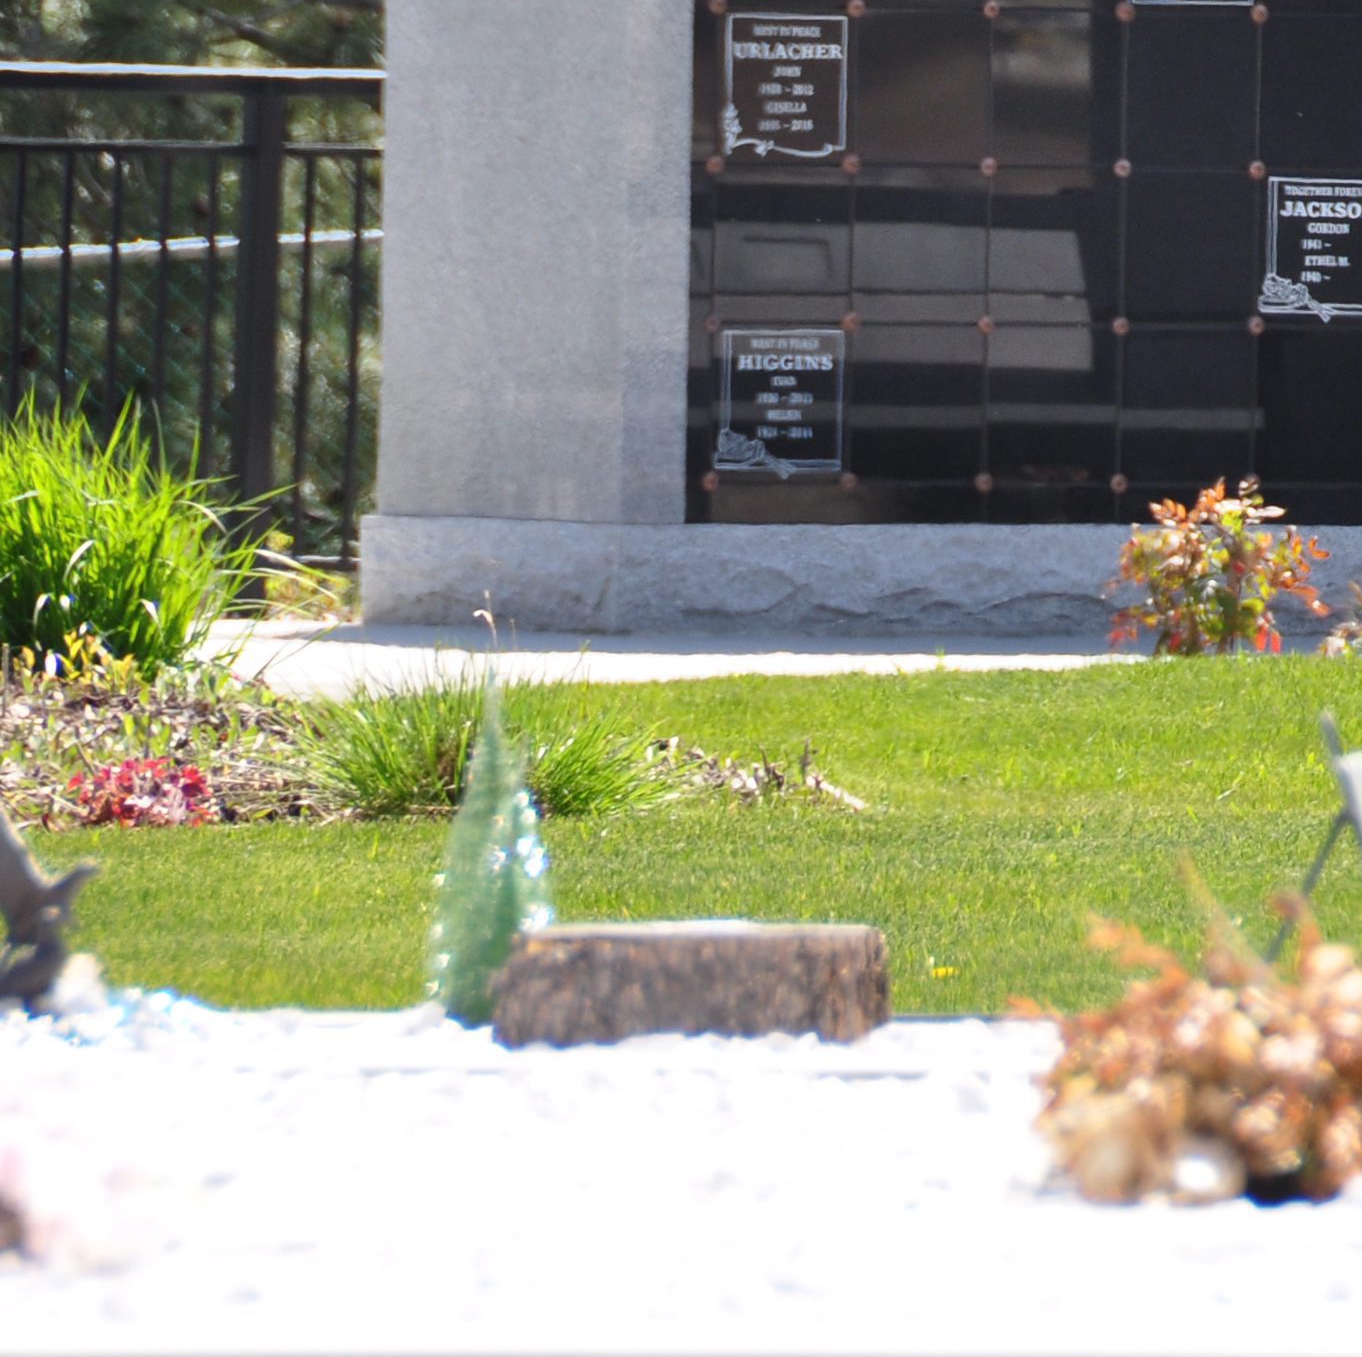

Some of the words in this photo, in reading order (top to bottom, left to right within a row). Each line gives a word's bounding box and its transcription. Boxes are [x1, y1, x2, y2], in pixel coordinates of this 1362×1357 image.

[754, 25, 778, 37] REST
[780, 27, 791, 37] IN
[792, 27, 821, 38] PEACE
[733, 42, 843, 60] URLACHER
[773, 66, 801, 77] JOHN
[1284, 185, 1333, 197] TOGETHER
[1307, 223, 1350, 234] GORDON
[1305, 256, 1337, 267] ETHEL
[738, 354, 834, 371] HIGGINS
